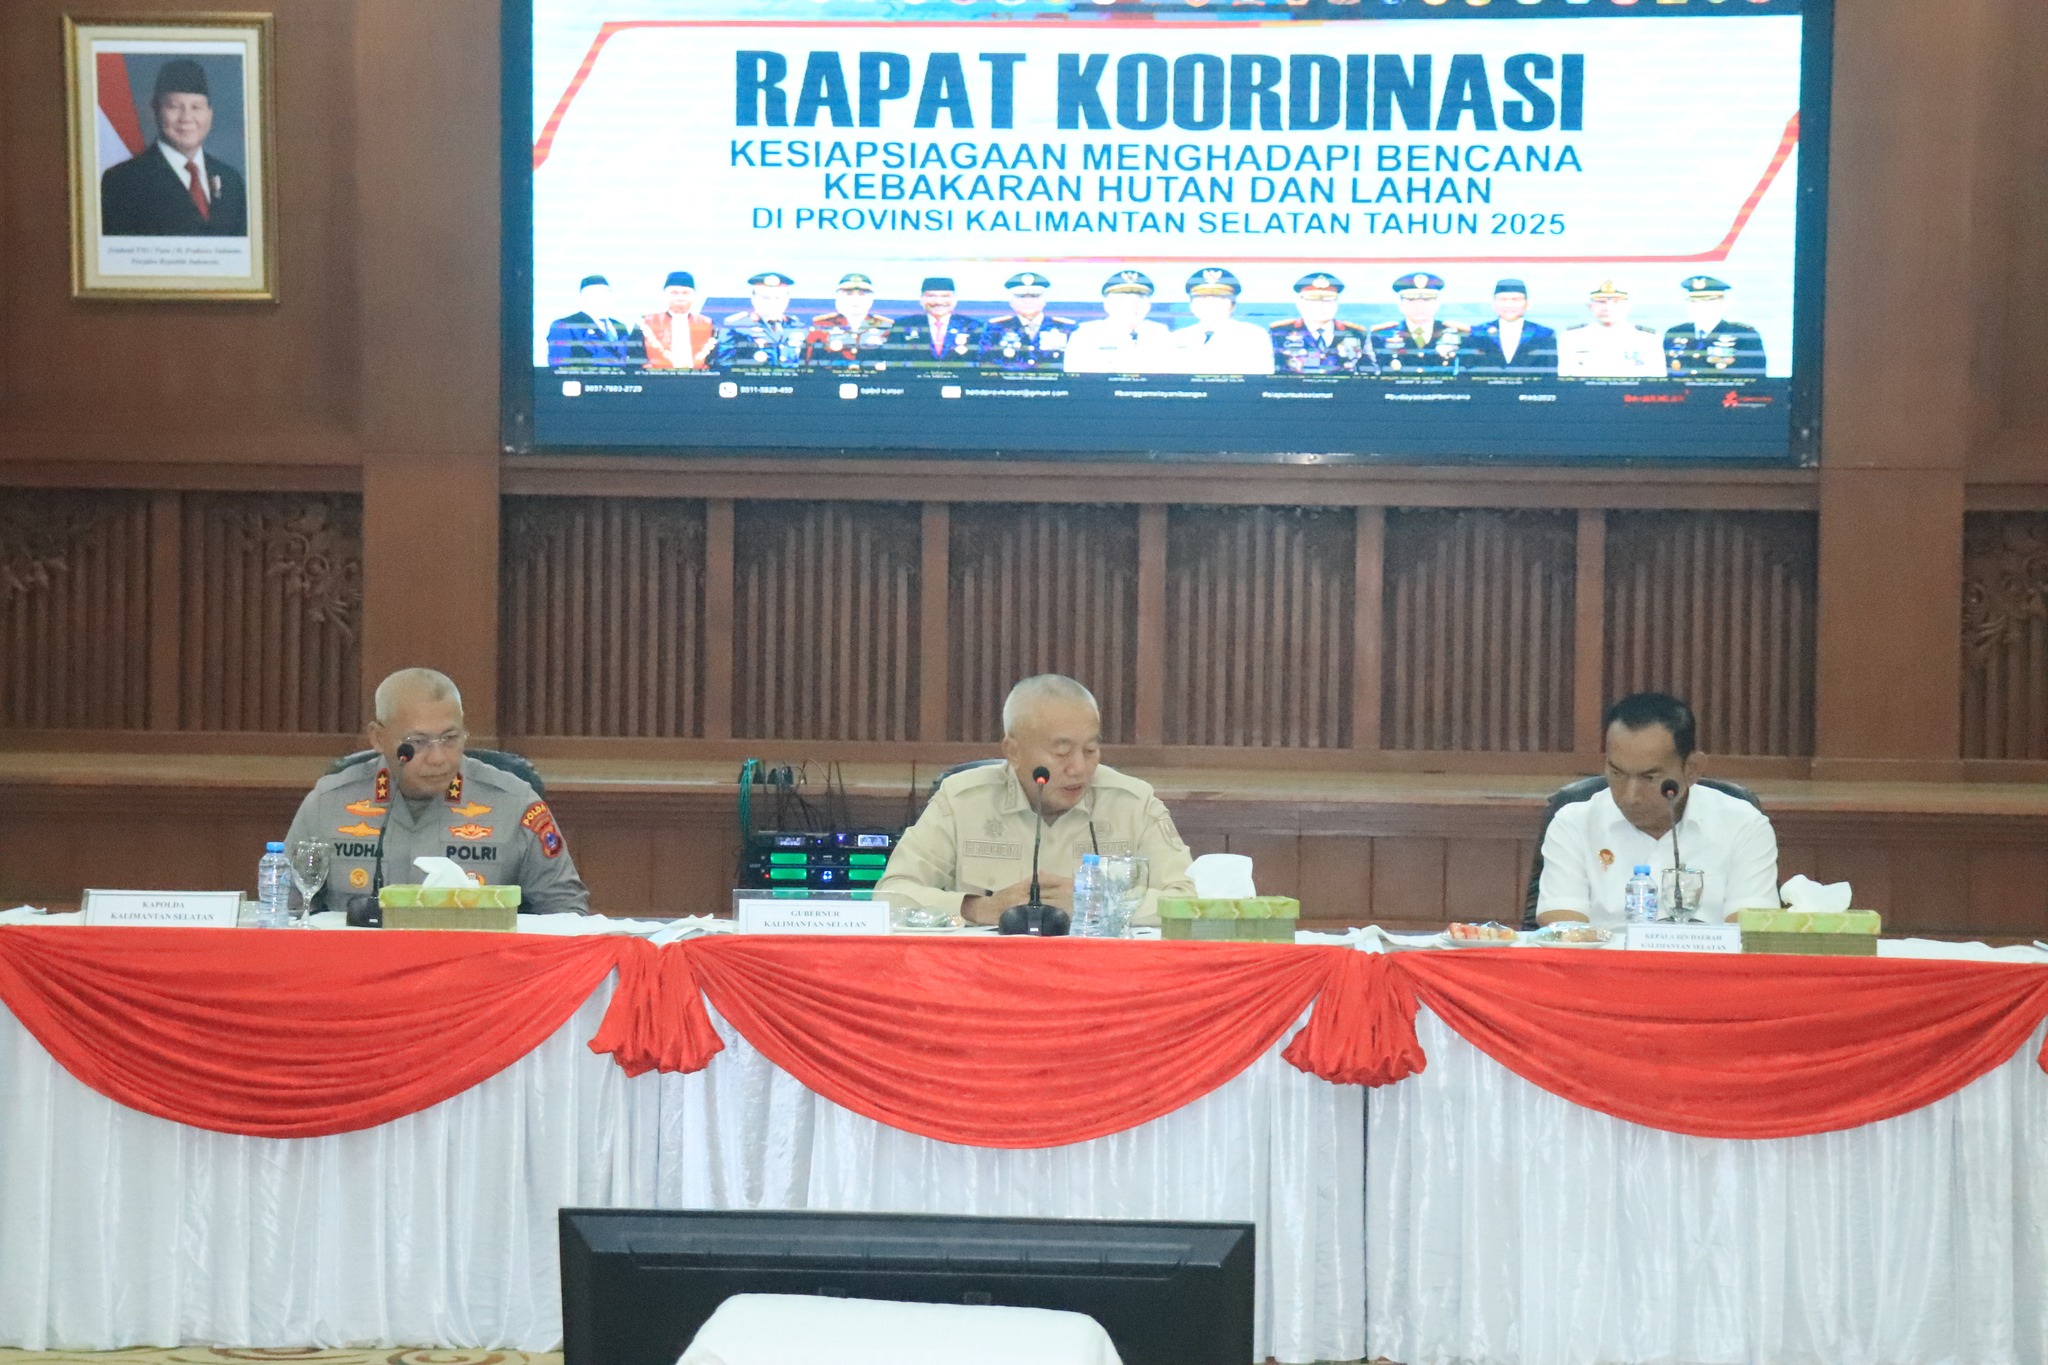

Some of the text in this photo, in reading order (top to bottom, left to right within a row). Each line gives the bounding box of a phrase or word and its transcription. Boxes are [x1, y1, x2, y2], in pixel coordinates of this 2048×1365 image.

[736, 51, 1584, 131] RAPAT KOORDINASI
[731, 140, 1582, 172] KESIAPSIAGAAN MENGHADAPI BENCANA
[825, 173, 1490, 203] KEBAKARAN HUTAN DAN LAHAN
[753, 208, 1565, 234] DI PROVINSI KALIMANTAN SELATAN TAHUN 2025
[523, 803, 547, 826] POLDA
[446, 846, 497, 860] POLRI
[143, 901, 185, 909] KAPOLDA
